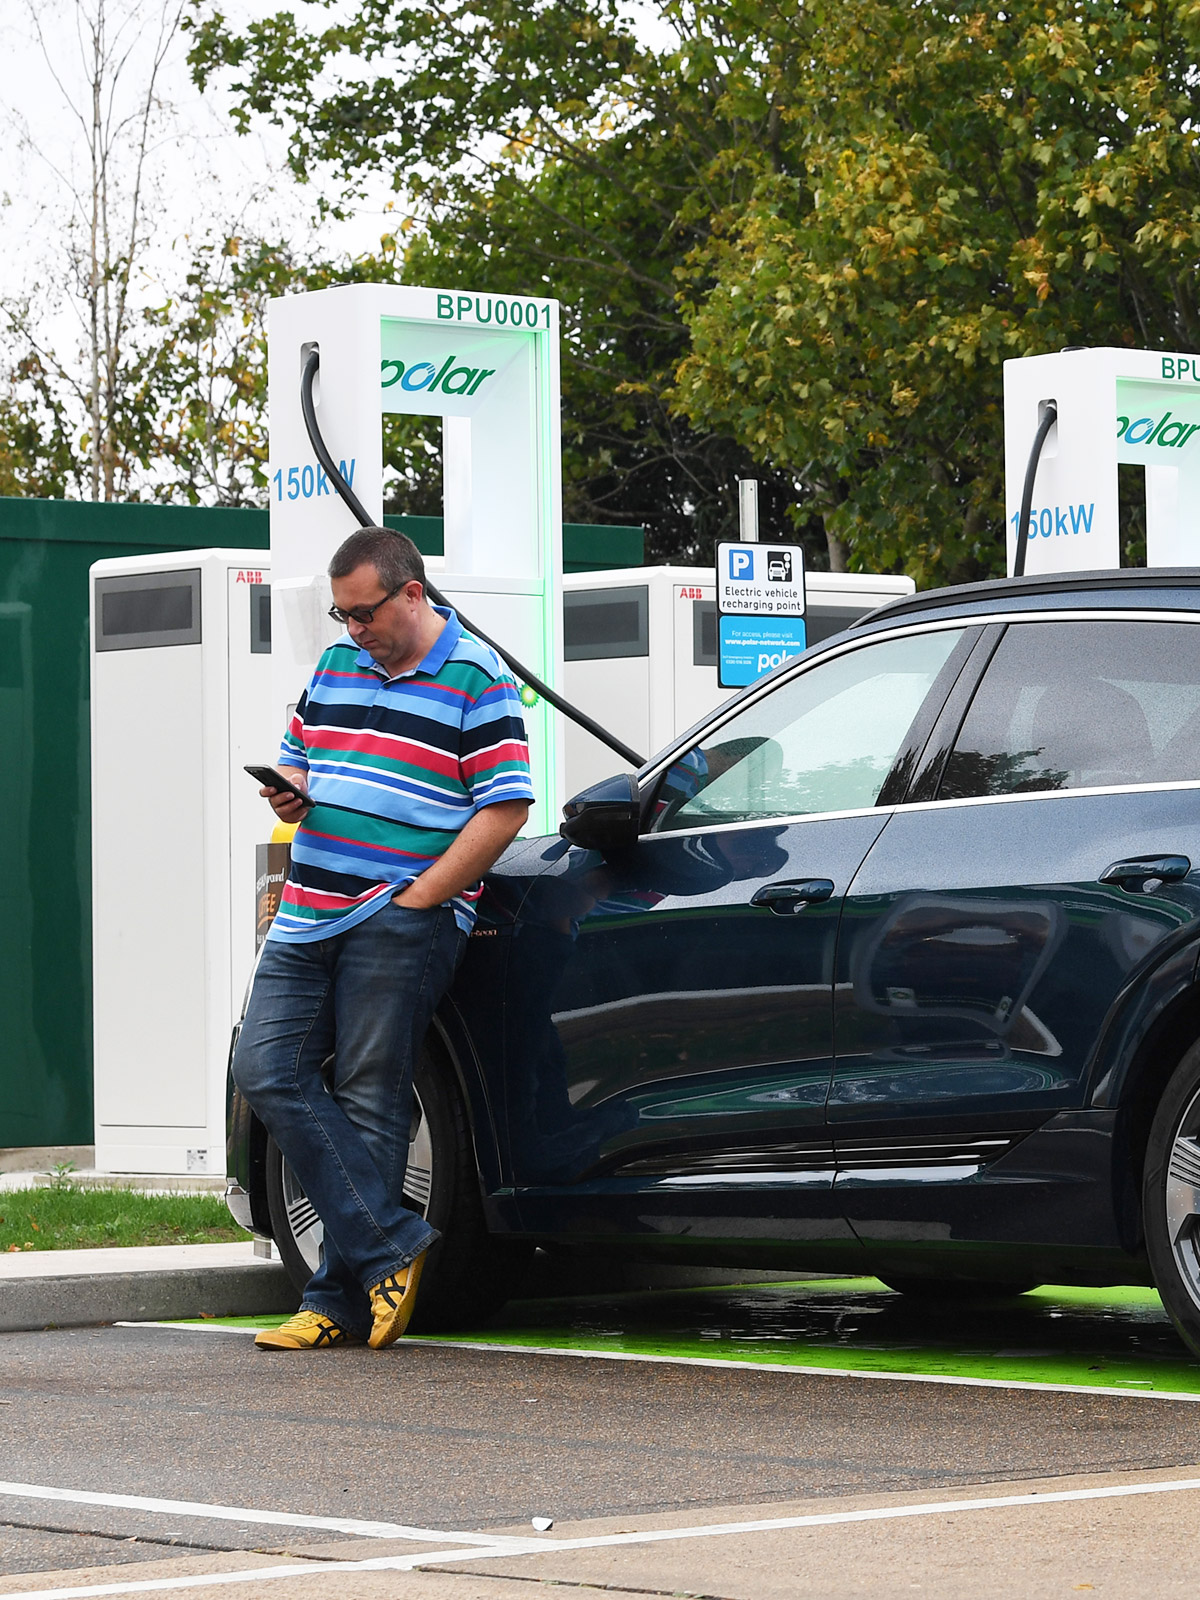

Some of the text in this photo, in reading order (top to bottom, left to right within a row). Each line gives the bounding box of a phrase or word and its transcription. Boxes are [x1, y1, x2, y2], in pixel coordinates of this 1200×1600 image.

[437, 294, 550, 329] BPU0001
[273, 458, 356, 501] 150kW
[1010, 503, 1094, 541] 150kW
[733, 552, 750, 577] P
[236, 570, 262, 584] ABB
[680, 587, 703, 599] ABB
[725, 586, 798, 598] Electric vehicle
[722, 599, 801, 611] recharging point
